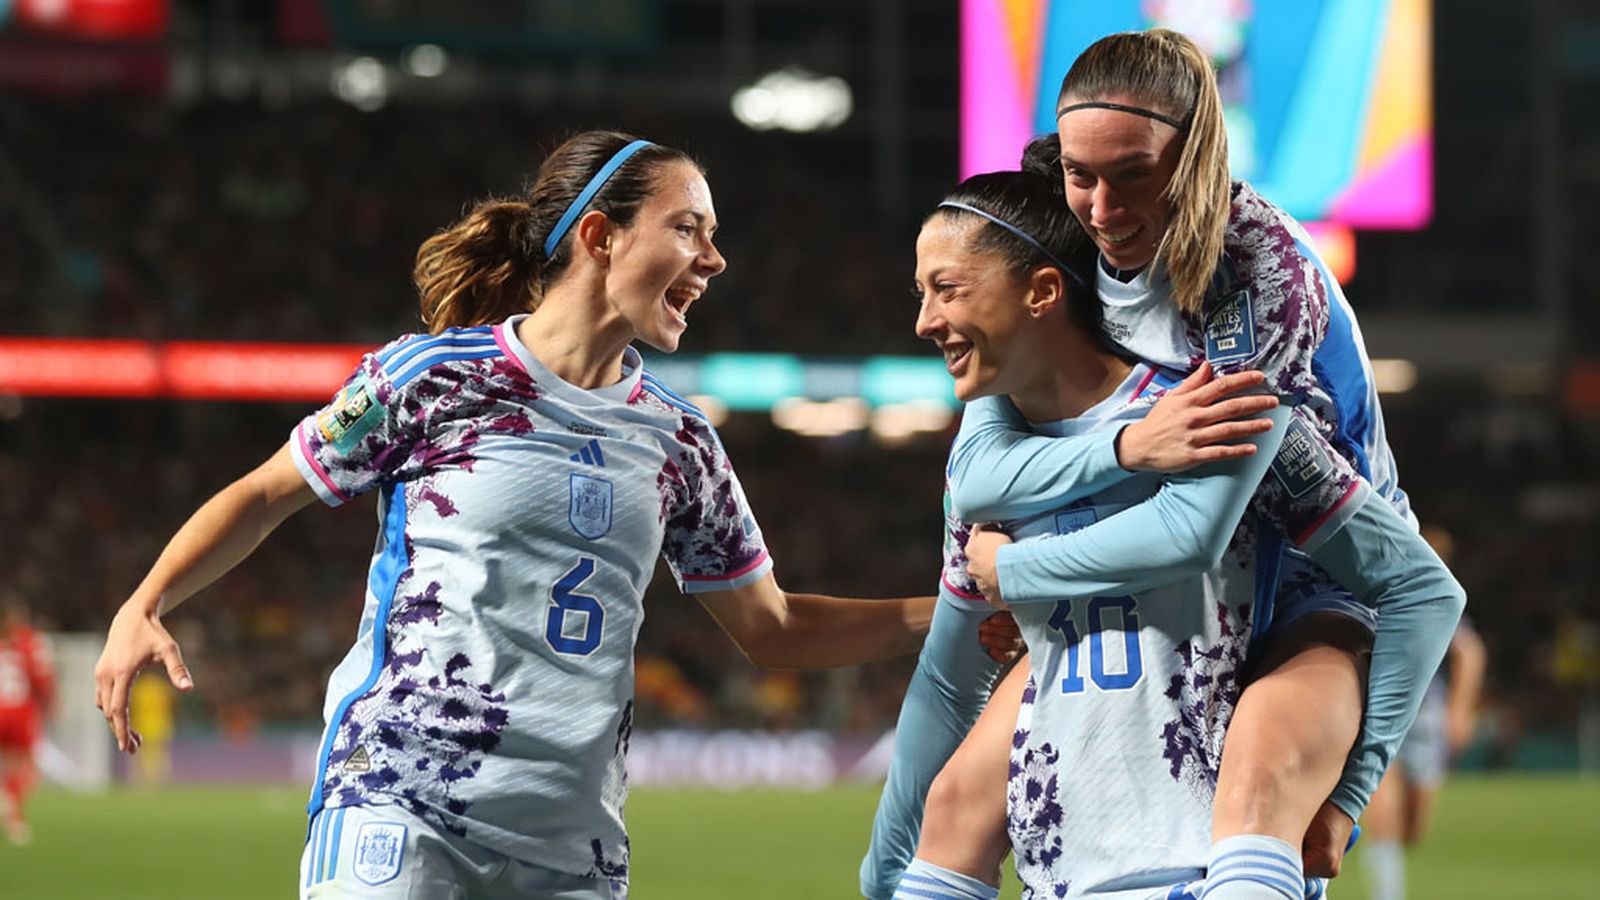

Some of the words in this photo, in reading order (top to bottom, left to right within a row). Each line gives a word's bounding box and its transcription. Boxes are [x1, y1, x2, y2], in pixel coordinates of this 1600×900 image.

[1279, 436, 1311, 465] UNITES
[1302, 463, 1318, 478] FIFA
[544, 555, 606, 658] 6
[1047, 595, 1145, 694] 10
